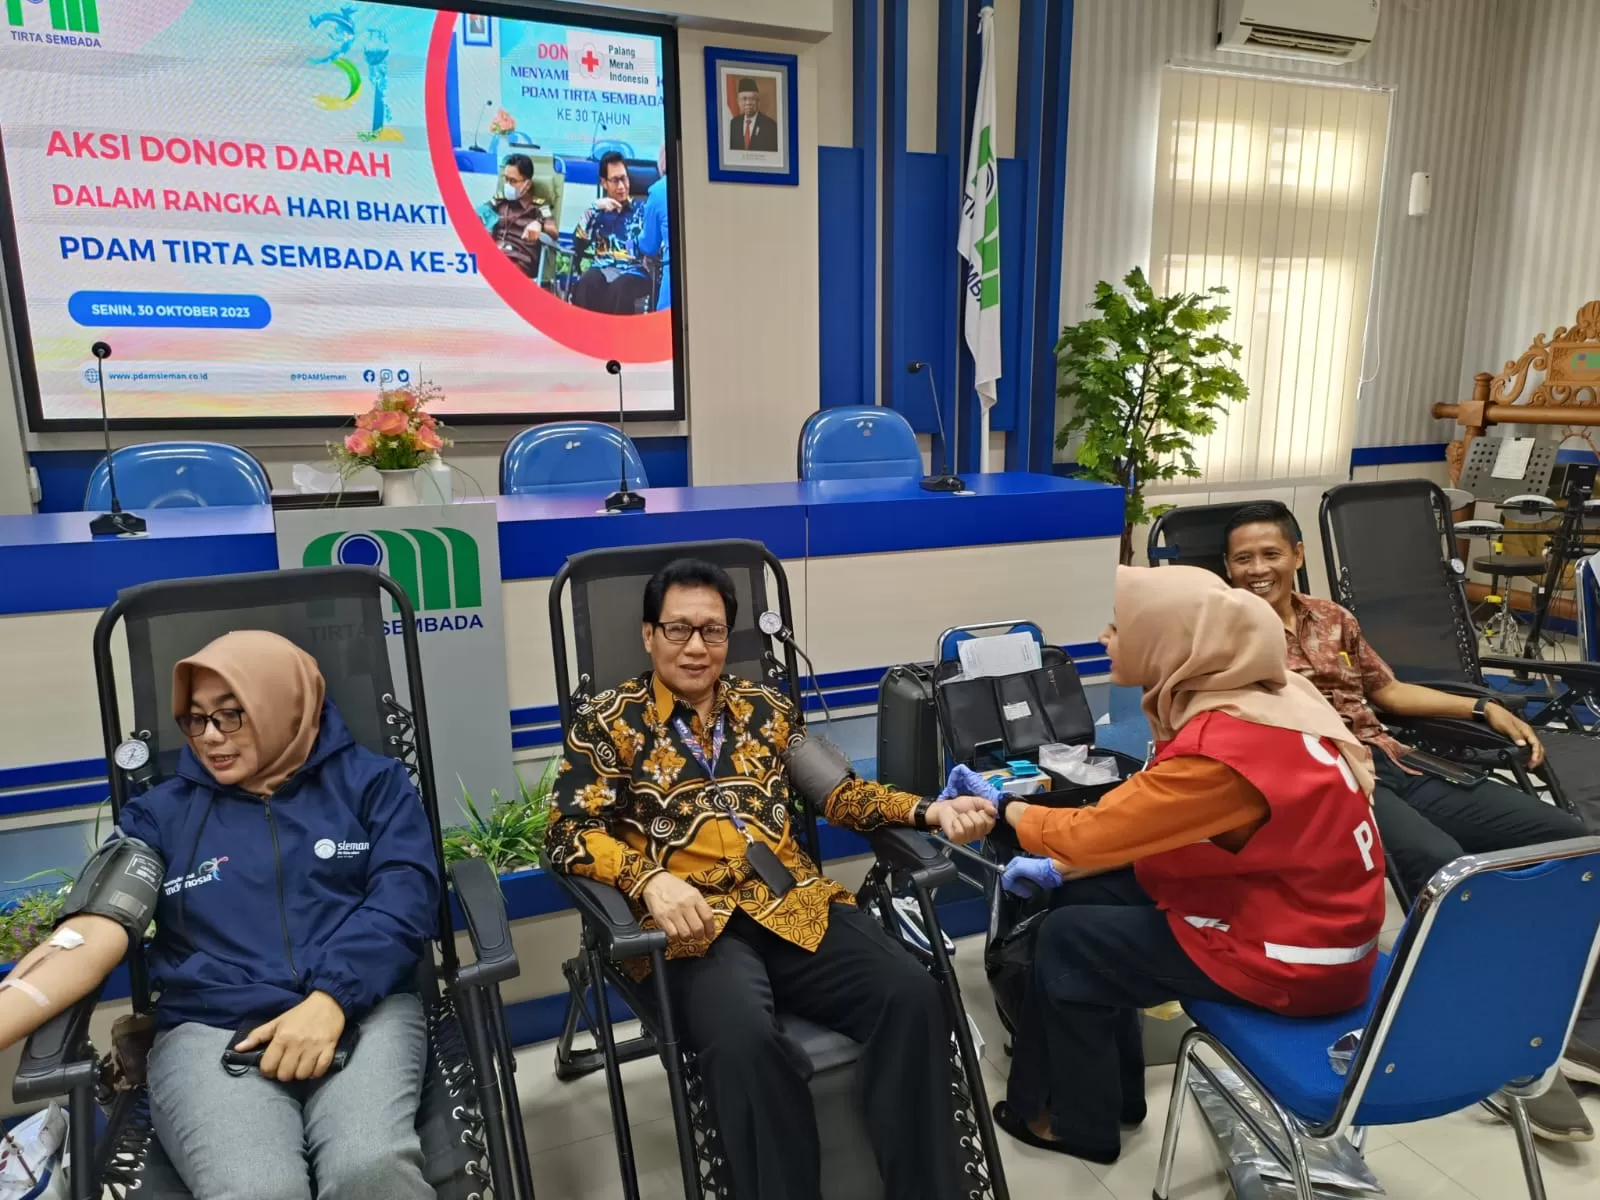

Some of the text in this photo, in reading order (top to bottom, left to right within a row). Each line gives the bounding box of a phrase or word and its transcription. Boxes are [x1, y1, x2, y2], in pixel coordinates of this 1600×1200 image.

[10, 30, 102, 48] TIRTA SEMBADA
[608, 45, 636, 58] Palang
[609, 59, 634, 70] Merah
[609, 72, 649, 85] Indonesia
[521, 86, 664, 107] PDAM TIRTA SEMBADA
[557, 108, 630, 125] KE 30 TAHUN
[46, 130, 391, 178] AKSI DONOR DARAH
[52, 184, 447, 225] DALAM RANGKA HARI BHAKTI
[59, 236, 478, 274] PDAM TIRTA SEMBADA KE-31
[91, 304, 250, 318] SENIN, 30 OKTOBER 2023
